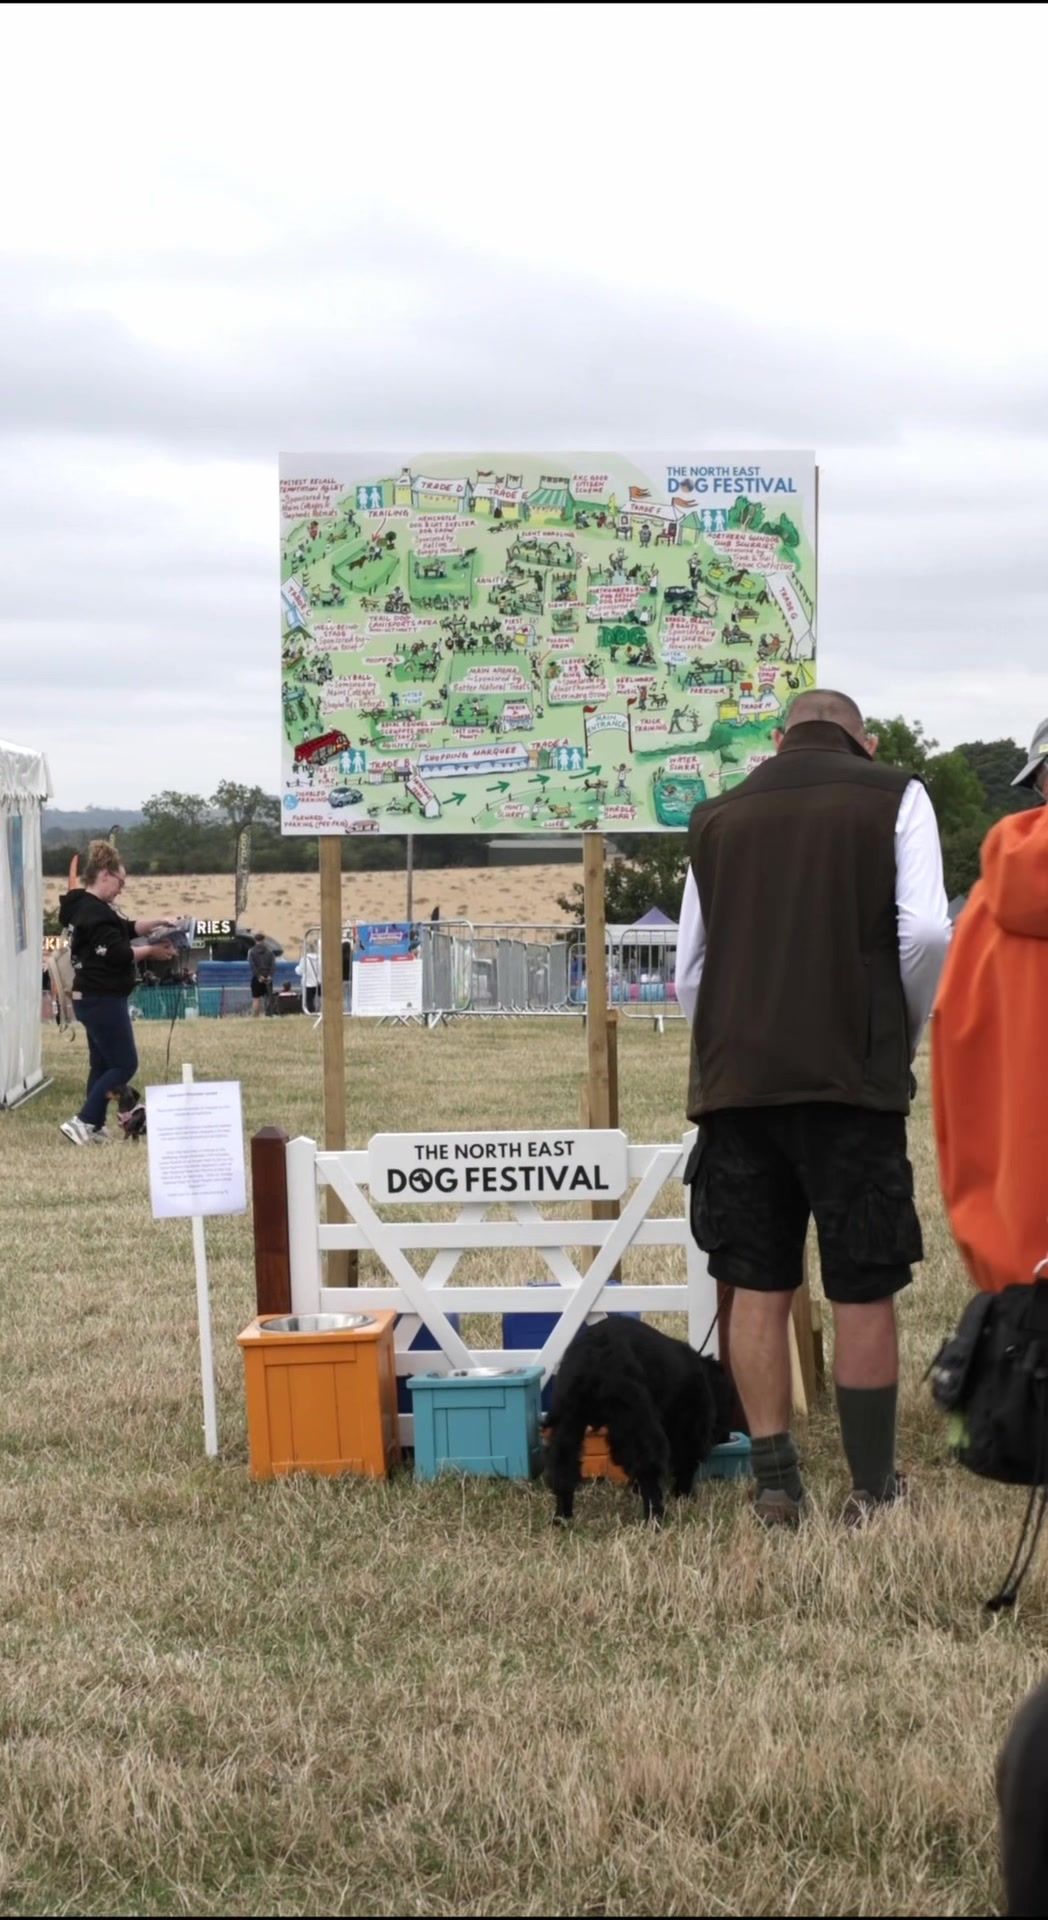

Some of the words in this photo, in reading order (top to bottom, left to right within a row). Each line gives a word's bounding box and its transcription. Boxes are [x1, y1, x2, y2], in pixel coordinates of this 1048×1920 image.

[666, 467, 687, 476] THE
[690, 467, 730, 476] NORTH
[732, 467, 761, 476] EAST
[421, 482, 453, 491] TRADE
[668, 478, 708, 493] DOG
[713, 478, 798, 493] FESTIVAL
[488, 488, 518, 499] TRADE
[521, 491, 528, 499] E
[368, 510, 409, 518] TRAILING
[631, 504, 654, 513] TRADE
[706, 533, 746, 541] NORTHERN
[288, 586, 306, 609] TRADE
[780, 587, 795, 613] TRADE
[790, 612, 798, 620] G
[587, 721, 627, 733] ENTRANCE
[531, 740, 560, 749] TRADE
[424, 753, 469, 762] SHOPPING
[473, 747, 517, 756] MARQUEE
[371, 760, 398, 769] TRADE
[404, 758, 411, 767] B
[544, 819, 565, 827] LURE
[196, 920, 231, 934] RIES
[414, 1144, 449, 1160] THE
[455, 1142, 522, 1159] NORTH
[528, 1140, 575, 1157] EAST
[387, 1167, 458, 1194] DOG
[465, 1165, 609, 1192] FESTIVAL
